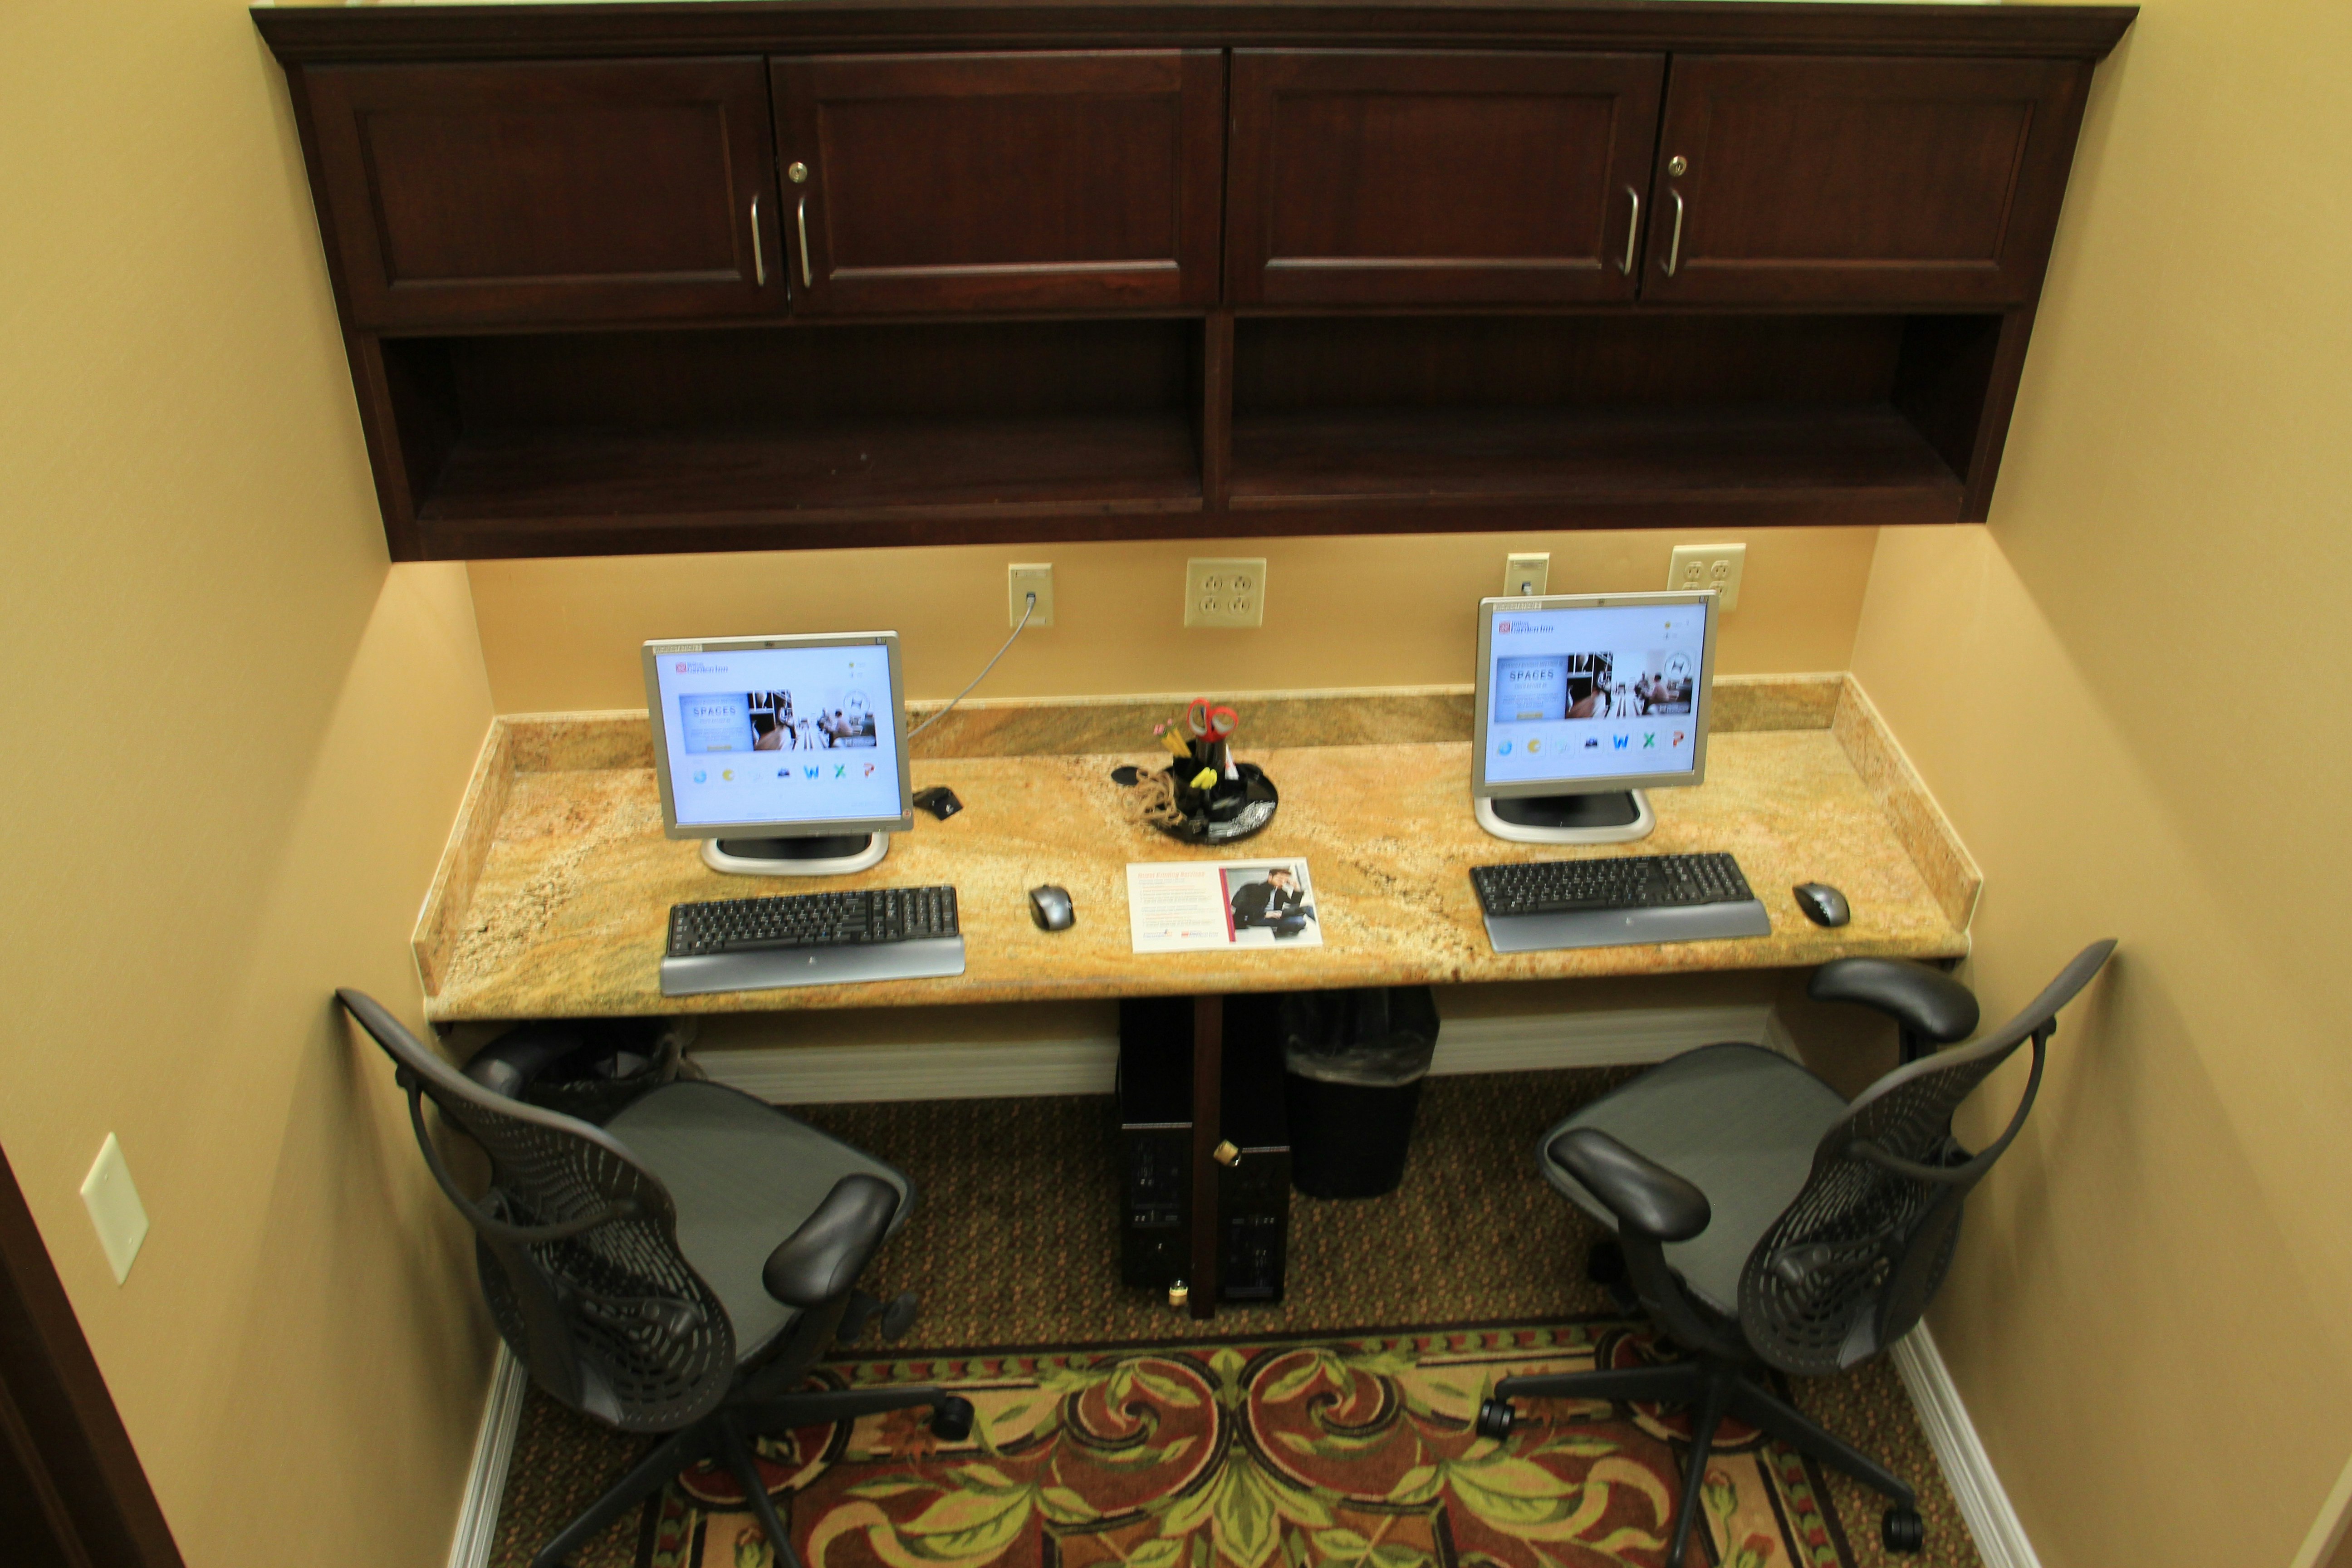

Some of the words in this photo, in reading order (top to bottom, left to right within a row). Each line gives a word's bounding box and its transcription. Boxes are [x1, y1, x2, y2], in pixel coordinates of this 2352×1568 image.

[1509, 669, 1554, 681] SPACES
[693, 705, 736, 717] SPACES
[1613, 734, 1629, 750] W
[1642, 732, 1655, 749] X
[1673, 730, 1684, 748] P
[804, 764, 819, 779] W
[834, 764, 847, 779] X
